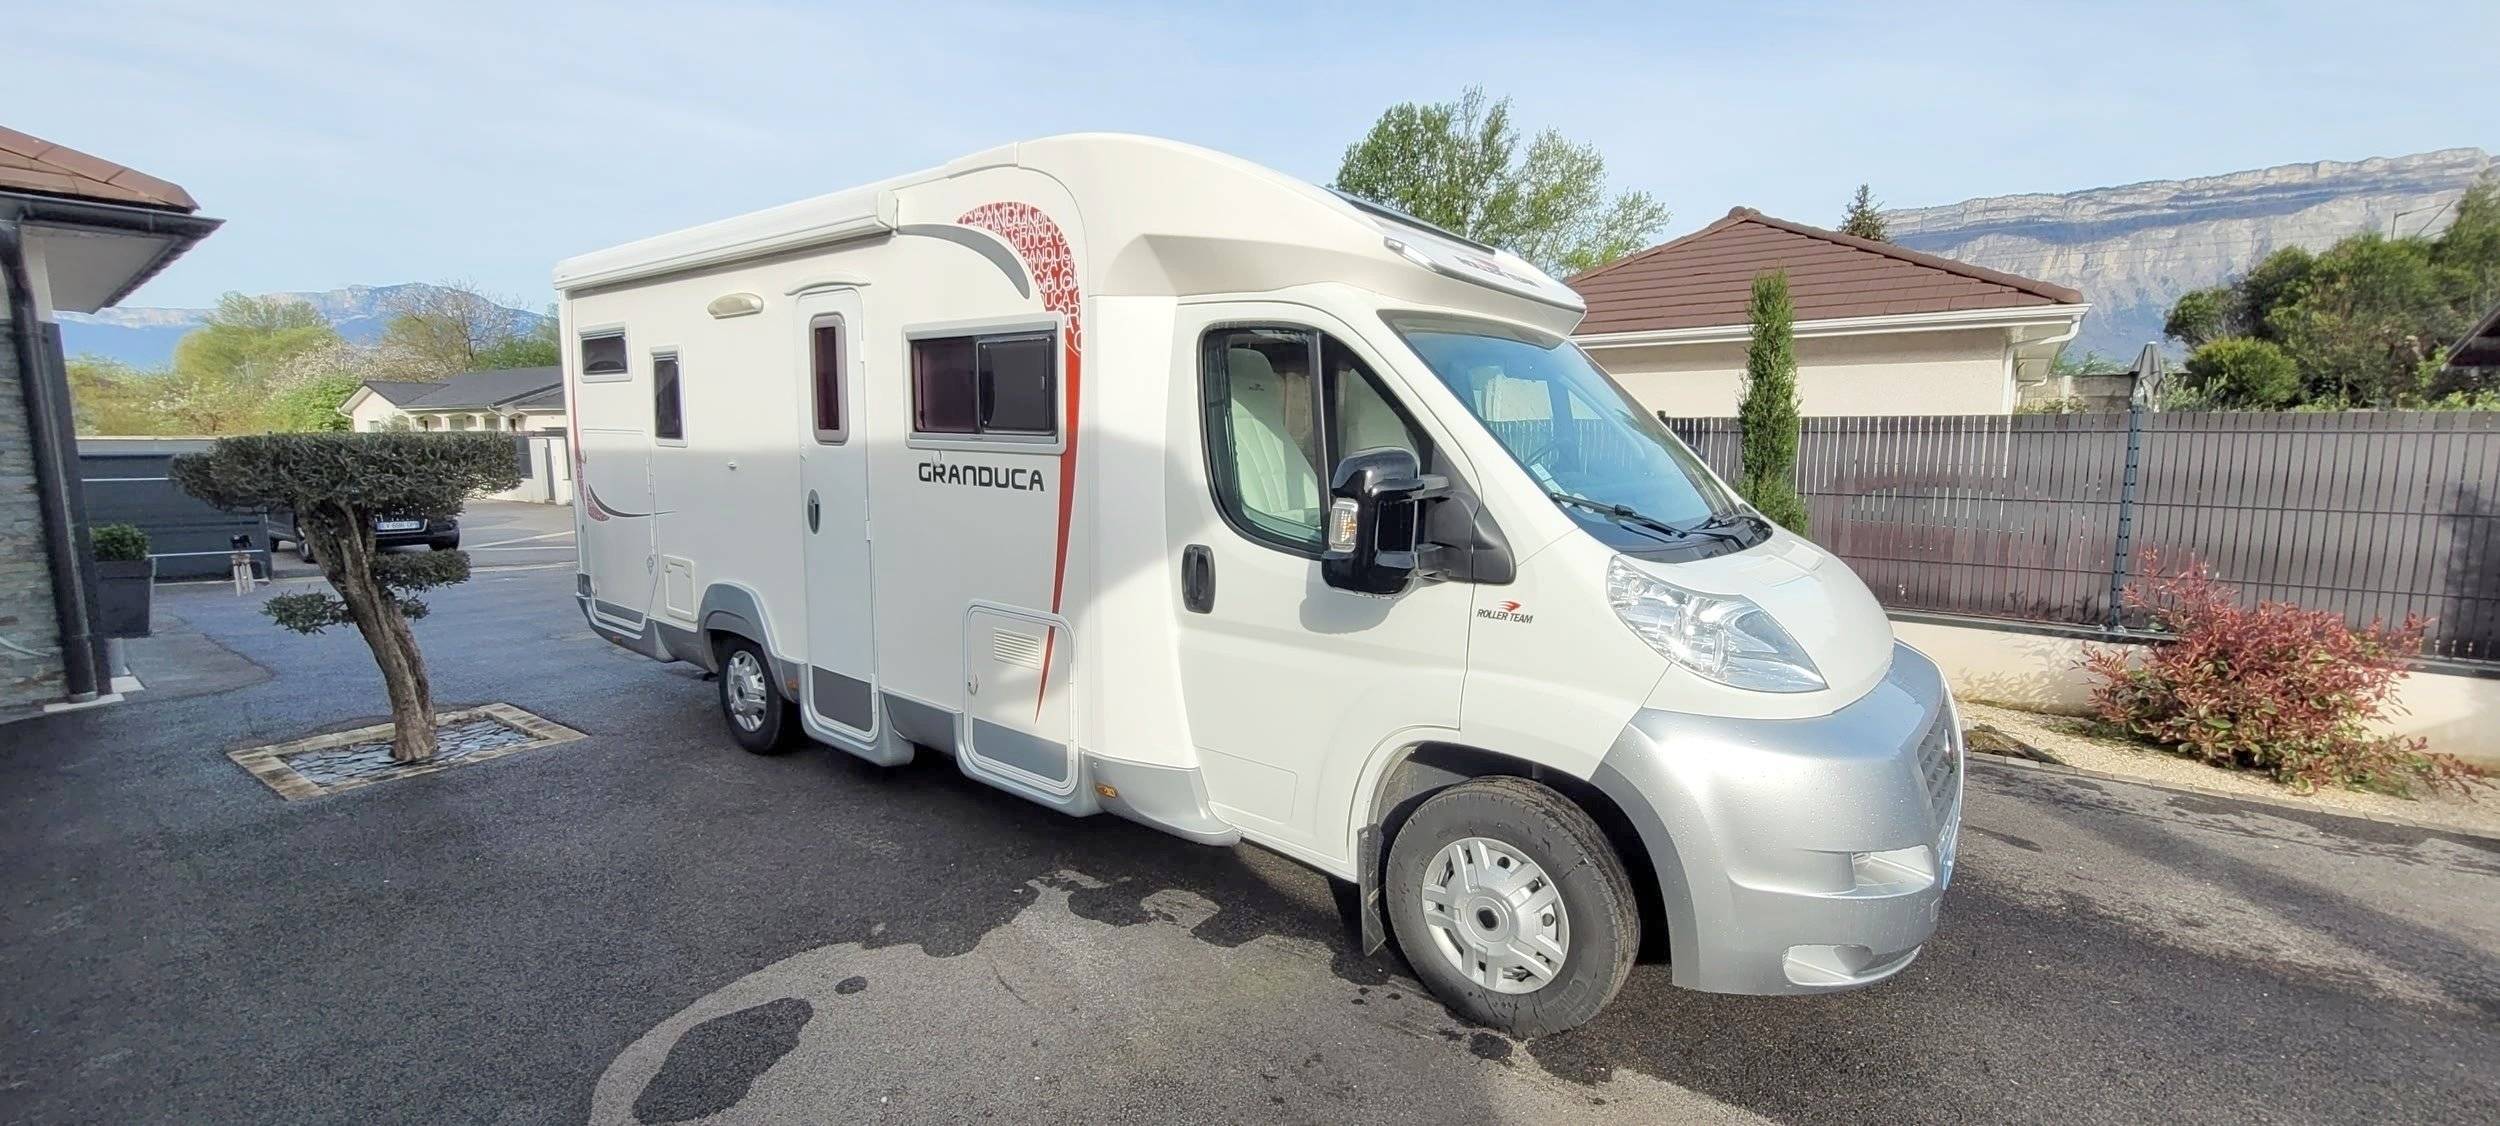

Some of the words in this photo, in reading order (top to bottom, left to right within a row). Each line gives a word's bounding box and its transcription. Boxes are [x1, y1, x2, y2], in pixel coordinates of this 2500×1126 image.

[918, 462, 1045, 491] GRANDUCA
[1476, 608, 1508, 620] ROLLER
[1509, 612, 1534, 624] TEAM
